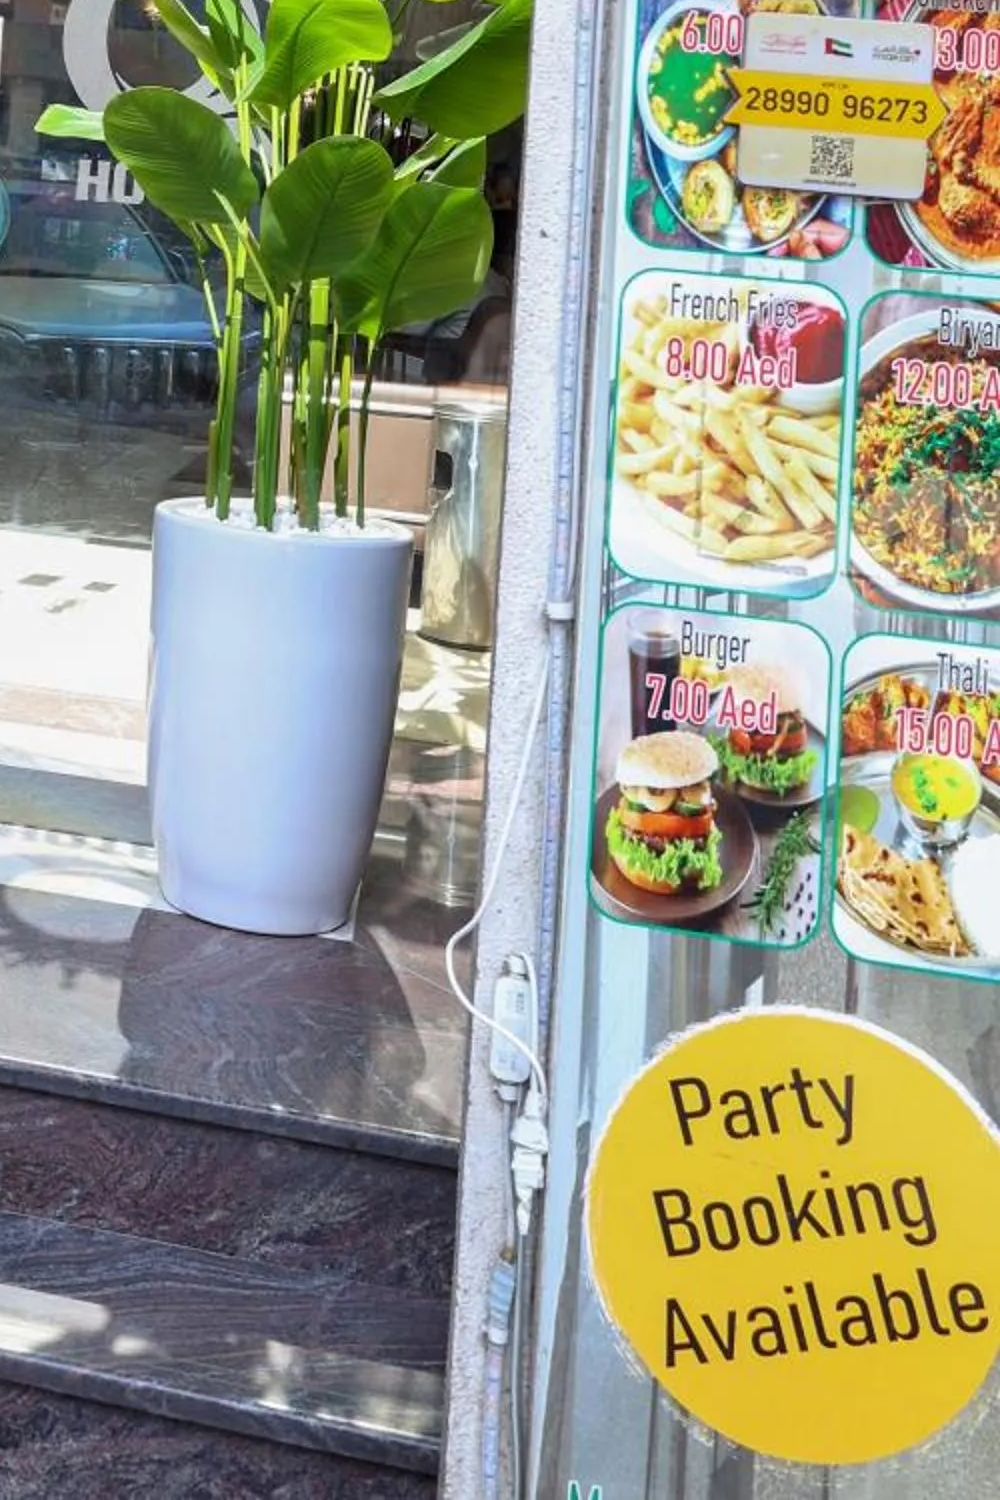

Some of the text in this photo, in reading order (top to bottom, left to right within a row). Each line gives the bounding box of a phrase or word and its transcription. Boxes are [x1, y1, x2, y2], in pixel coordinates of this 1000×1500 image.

[681, 12, 743, 54] 6.00
[936, 27, 1000, 71] 3.00
[745, 87, 929, 125] 28990 96273
[670, 283, 798, 330] French Fries
[665, 337, 797, 389] 8.00 Aed
[892, 358, 971, 408] 12.00
[679, 620, 751, 670] Burger
[936, 652, 991, 693] Thali
[645, 674, 778, 734] 7.00 Aed
[895, 706, 973, 758] 15.00
[669, 1067, 855, 1147] Party
[652, 1170, 938, 1258] Booking
[664, 1268, 990, 1369] Available
